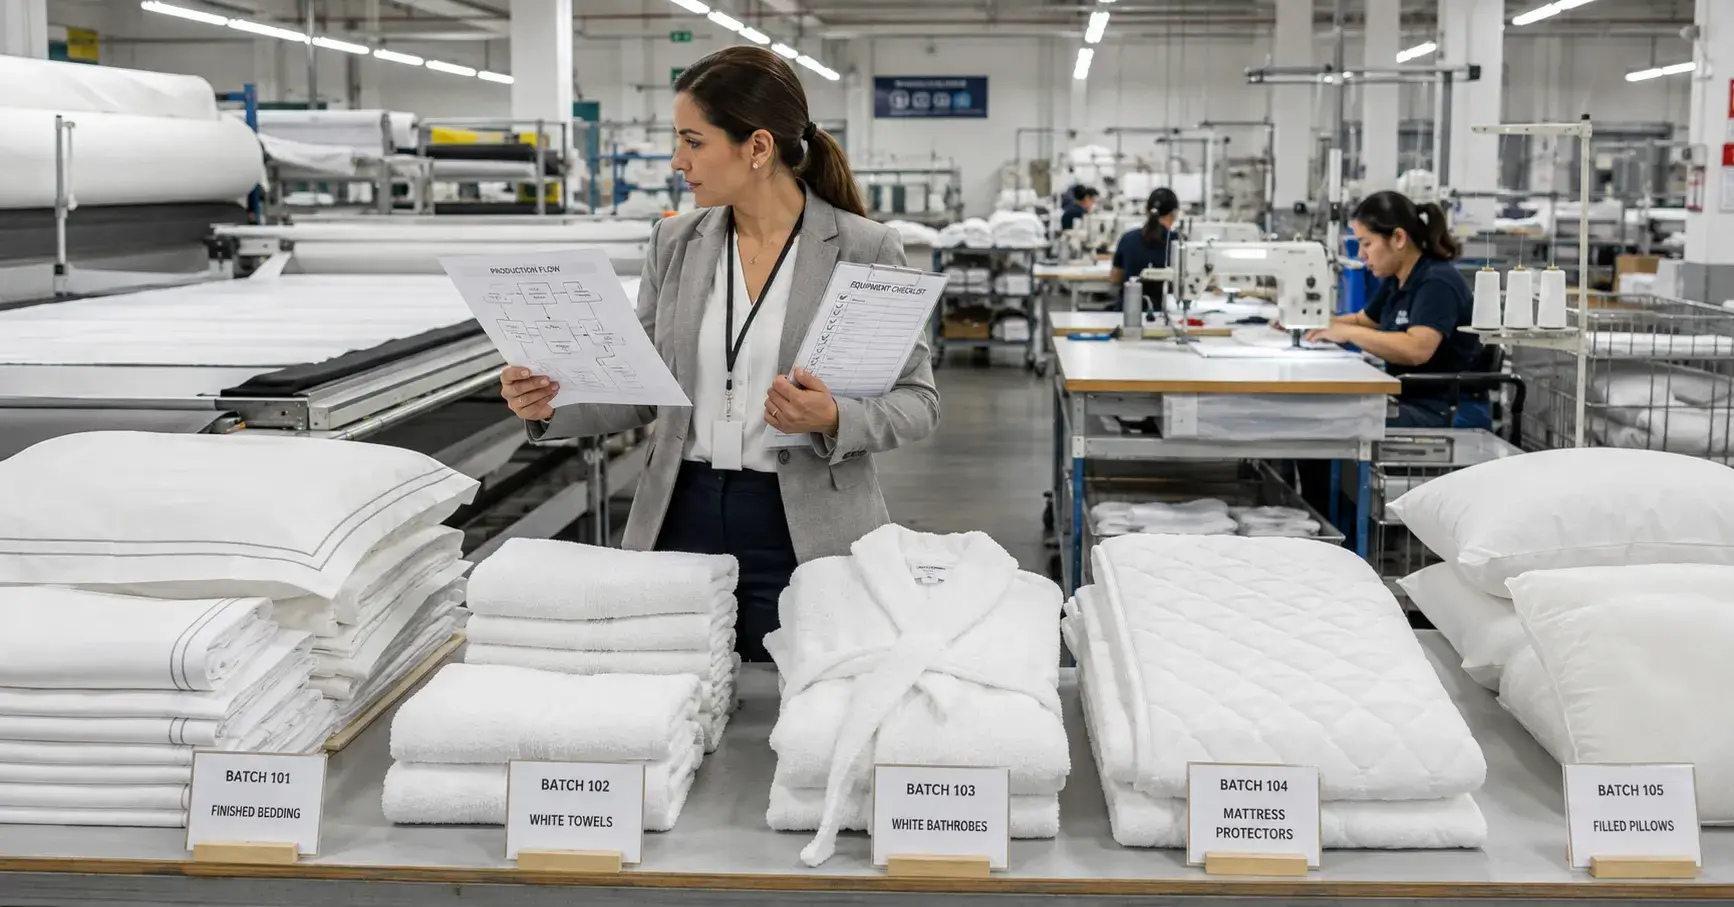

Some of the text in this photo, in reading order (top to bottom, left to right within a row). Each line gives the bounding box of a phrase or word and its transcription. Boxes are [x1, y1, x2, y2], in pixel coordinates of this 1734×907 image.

[490, 265, 560, 275] PRODUCTION FLOW
[226, 770, 289, 784] BATCH 101
[542, 779, 609, 792] BATCH 102
[907, 783, 975, 796] BATCH 103
[1221, 779, 1288, 792] BATCH 104
[1598, 784, 1664, 796] BATCH 105
[211, 805, 300, 819] FINISHED BEDDING
[1224, 808, 1285, 820] MATTRESS
[530, 814, 612, 827] WHITE TOWELS
[892, 818, 987, 832] WHITE BATHROBES
[1594, 820, 1674, 832] FILLED PILLOWS
[1216, 827, 1293, 840] PROTECTORS
